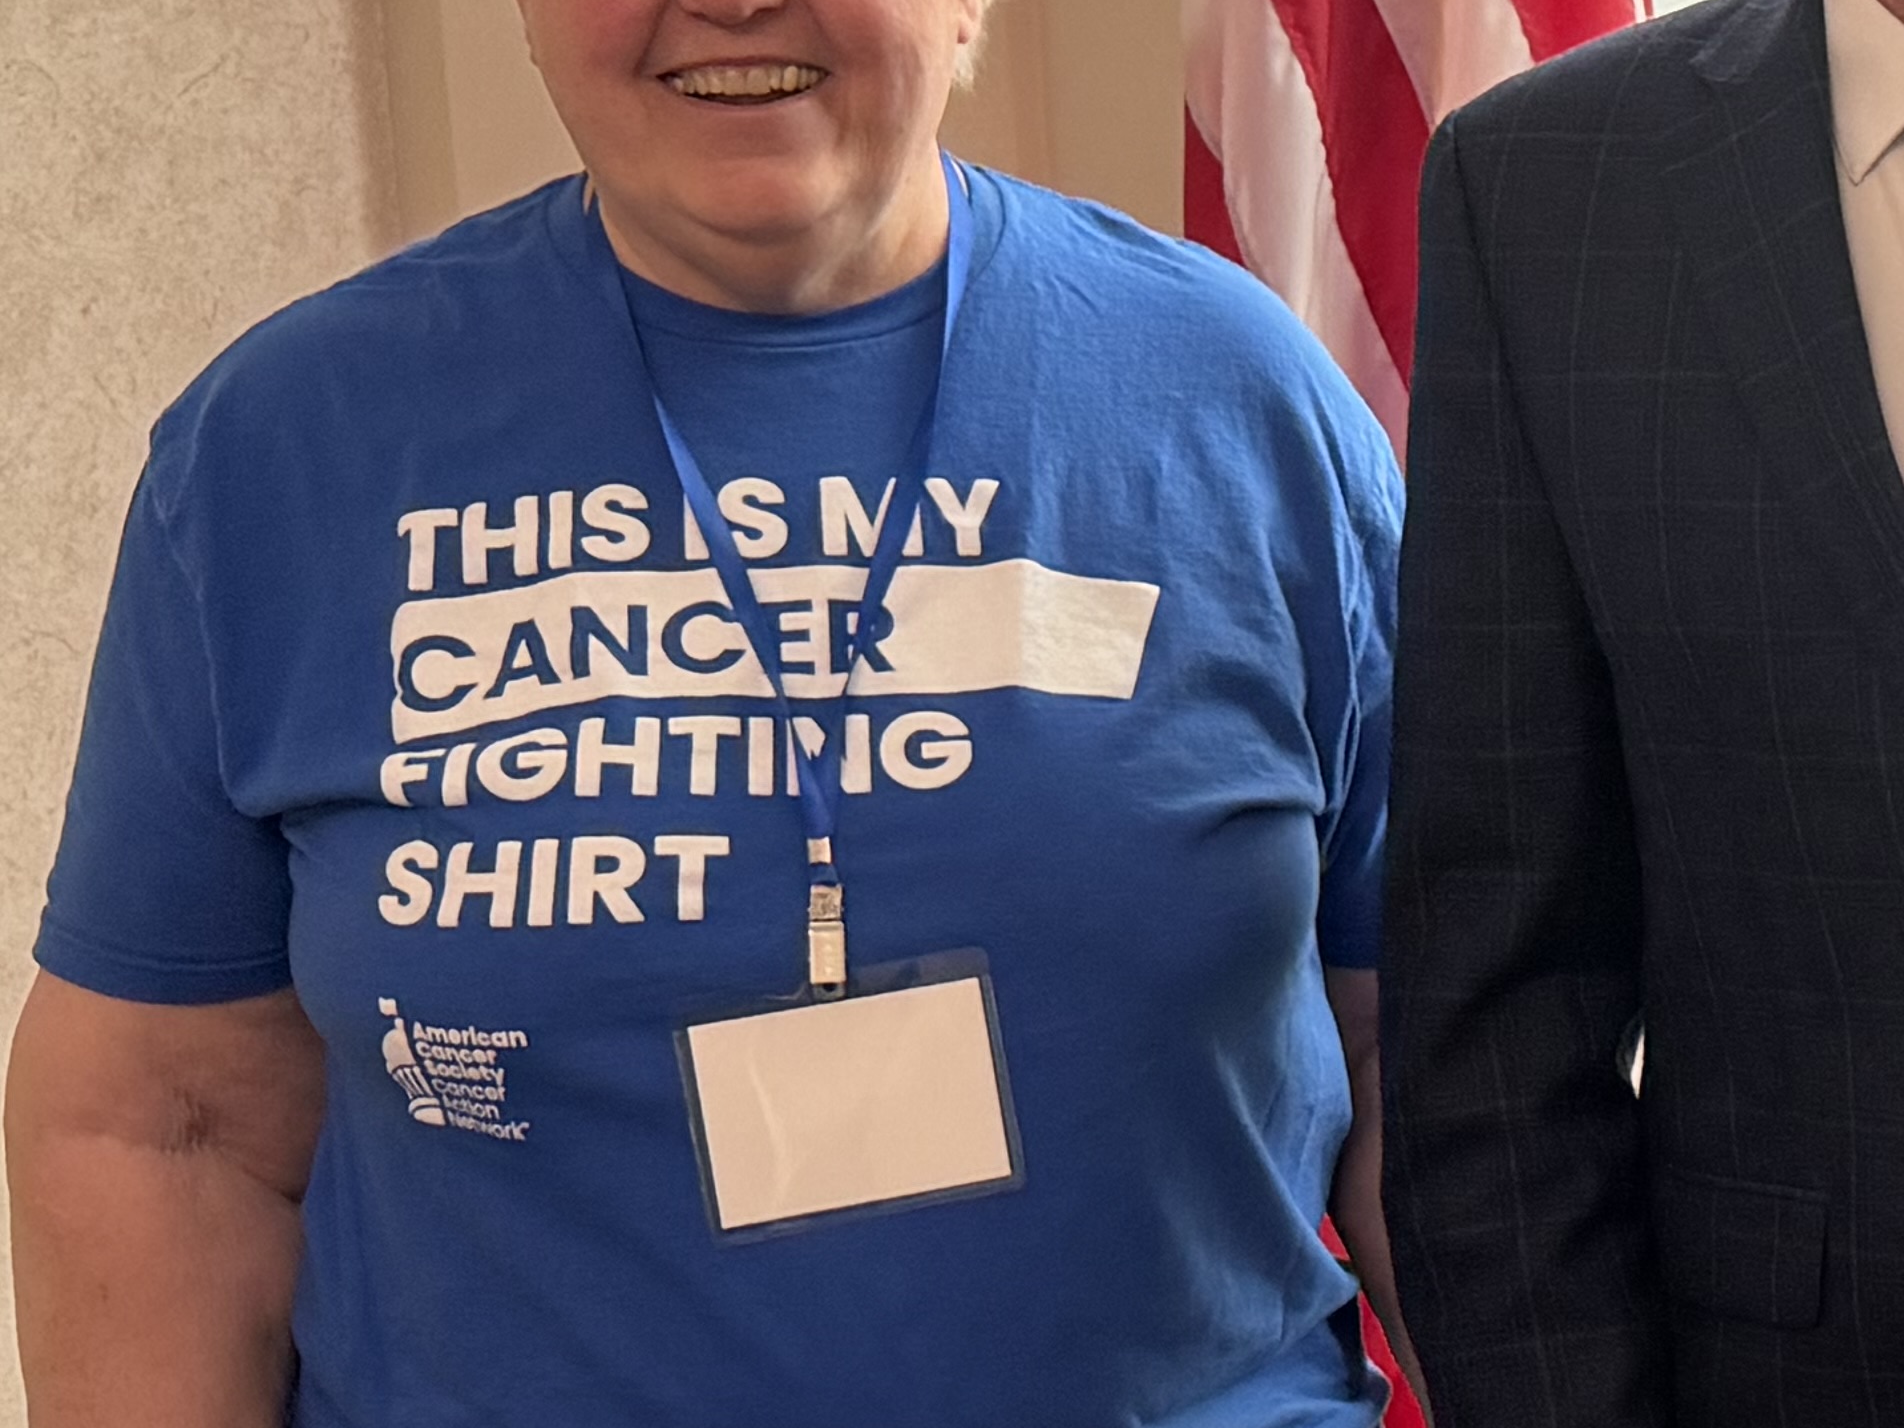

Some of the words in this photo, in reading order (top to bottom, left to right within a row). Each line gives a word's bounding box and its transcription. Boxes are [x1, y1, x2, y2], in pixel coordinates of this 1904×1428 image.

[398, 483, 651, 591] THIS
[819, 475, 1000, 558] MY
[400, 599, 896, 711] CANCER
[380, 710, 973, 807] FIGHTING
[378, 834, 731, 928] SHIRT
[413, 1021, 528, 1048] American
[415, 1041, 497, 1065] Cancer
[424, 1059, 505, 1086] Society
[431, 1078, 506, 1102] Cancer
